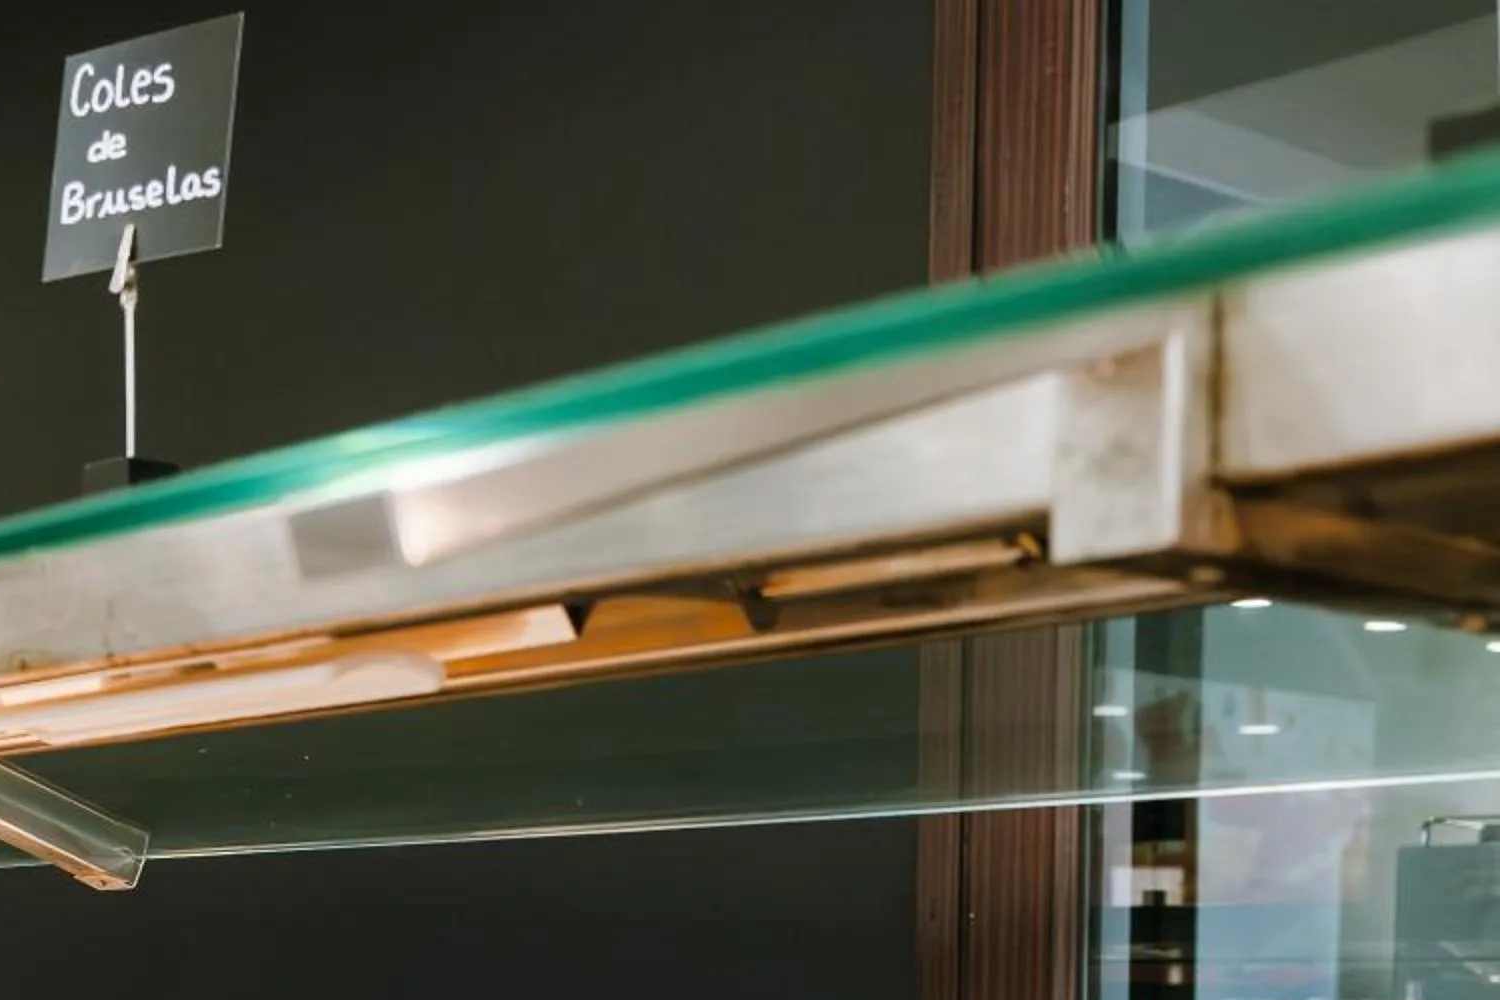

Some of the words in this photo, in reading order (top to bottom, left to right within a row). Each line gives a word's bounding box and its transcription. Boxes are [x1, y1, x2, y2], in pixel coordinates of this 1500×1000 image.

[69, 62, 176, 118] Coles
[86, 130, 128, 164] de
[60, 165, 222, 226] Bruselas
